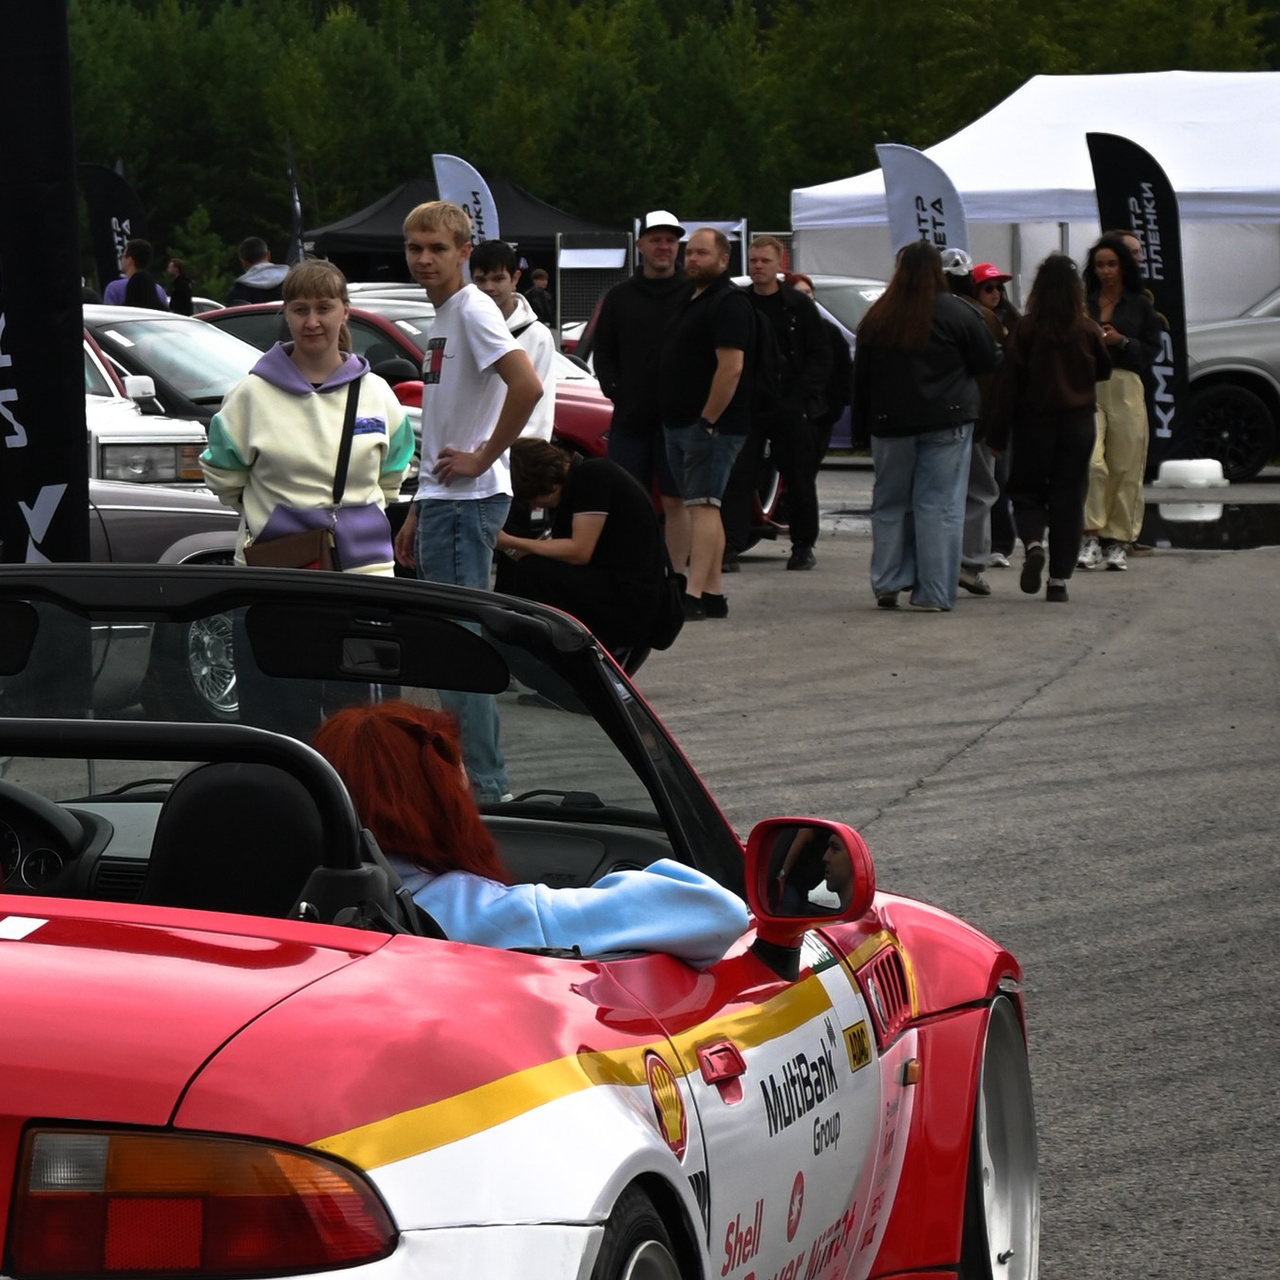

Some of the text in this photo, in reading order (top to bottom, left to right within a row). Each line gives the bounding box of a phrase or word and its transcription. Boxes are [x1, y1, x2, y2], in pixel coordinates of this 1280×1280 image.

[1140, 182, 1165, 280] ПЛЕНКИ
[760, 1038, 838, 1138] MultiBank
[813, 1111, 841, 1156] Group
[721, 1198, 764, 1277] Shell
